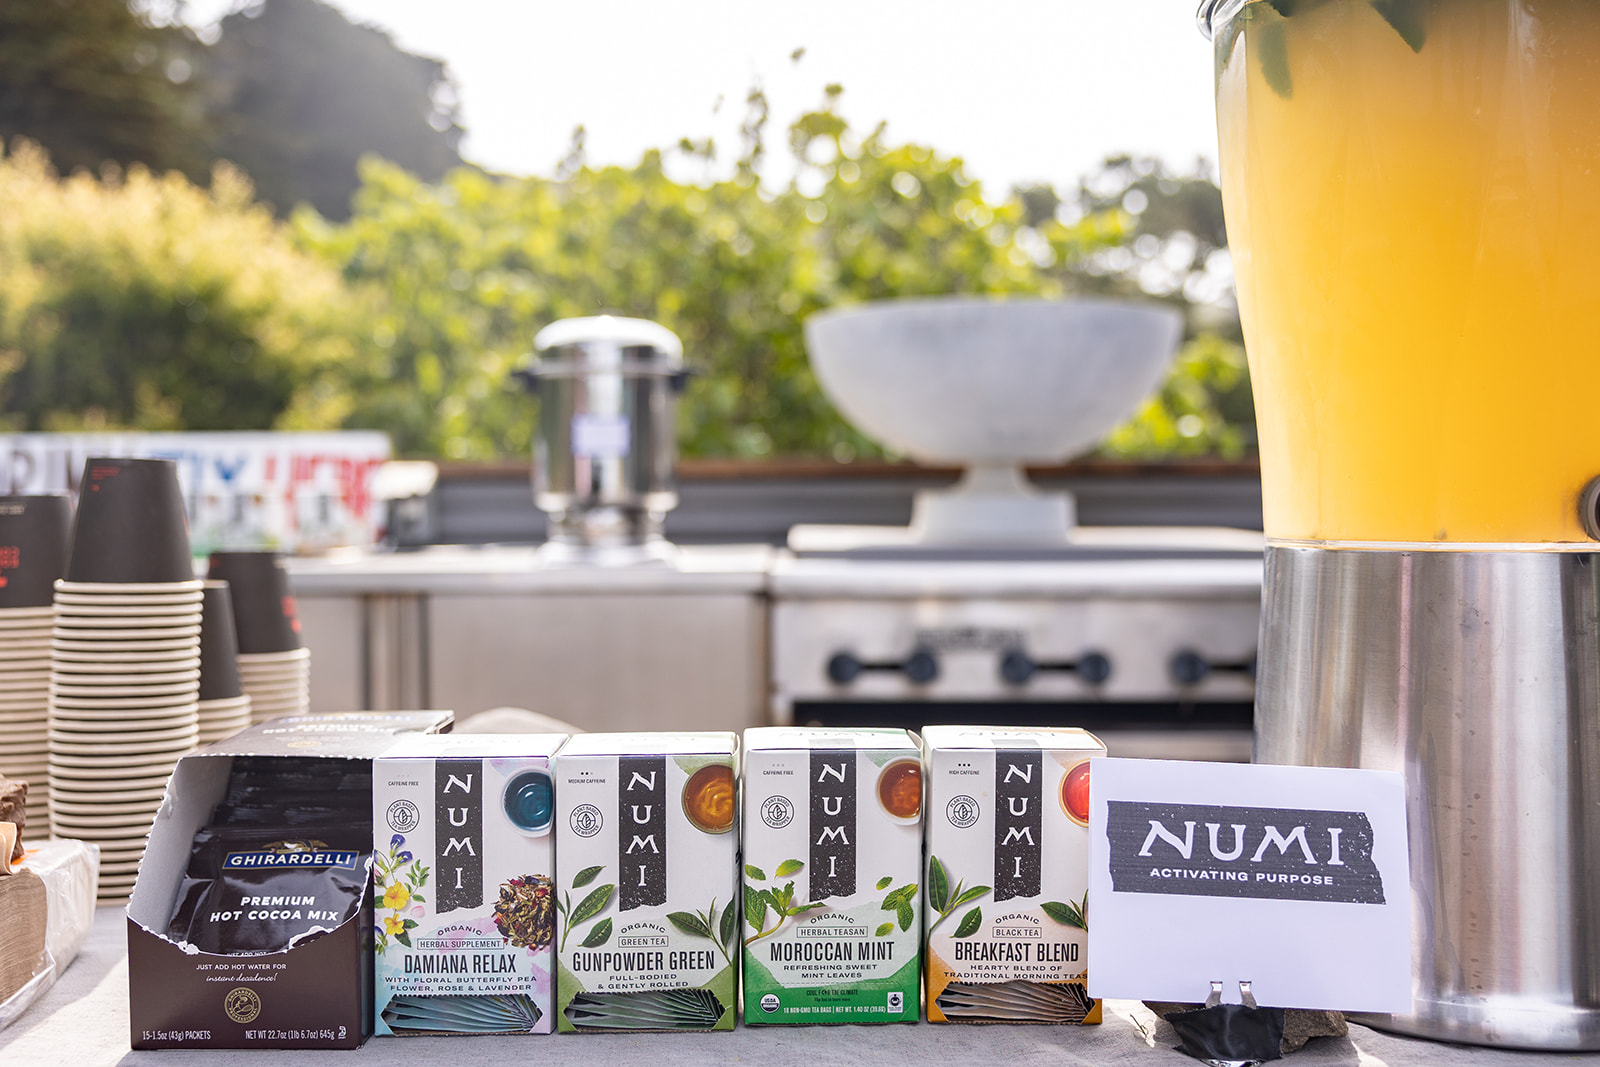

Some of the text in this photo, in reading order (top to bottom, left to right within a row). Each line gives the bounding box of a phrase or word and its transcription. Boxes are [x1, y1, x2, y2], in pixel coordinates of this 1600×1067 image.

[816, 763, 849, 877] NUMI
[1001, 764, 1035, 878] NUMI
[442, 773, 476, 889] NUMI
[625, 771, 660, 887] NUMI
[1138, 819, 1345, 866] NUMI
[230, 854, 351, 866] GHIRARDELLI
[1150, 867, 1334, 885] ACTIVATING PURPOSE
[240, 896, 316, 907] PREMIUM
[209, 910, 339, 923] HOT COCOA MIX
[810, 913, 855, 924] ORGANIC
[995, 913, 1040, 925] ORGANIC
[437, 925, 483, 936] ORGANIC
[620, 922, 666, 934] ORGANIC
[800, 928, 866, 936] HERBAL TEASAN
[995, 929, 1039, 937] BLACK TEA
[419, 940, 501, 949] HERBAL SUPPLEMENT
[621, 937, 666, 946] GREEN TEA
[770, 941, 895, 962] MOROCCAN MINT
[955, 942, 1079, 962] BREAKFAST BLEND
[404, 953, 517, 974] DAMIANA RELAX
[572, 950, 715, 972] GUNPOWDER GREEN
[235, 972, 279, 982] decadence!
[609, 973, 677, 981] FULL-BODIED
[142, 1030, 168, 1040] 15-1.5oz
[168, 1030, 185, 1042] (43g)
[184, 1030, 212, 1040] PACKETS
[245, 1030, 257, 1040] NET
[257, 1030, 267, 1040] WT
[267, 1029, 287, 1040] 22.7oz
[300, 1029, 319, 1040] 6.7oz)
[319, 1029, 335, 1041] 645g
